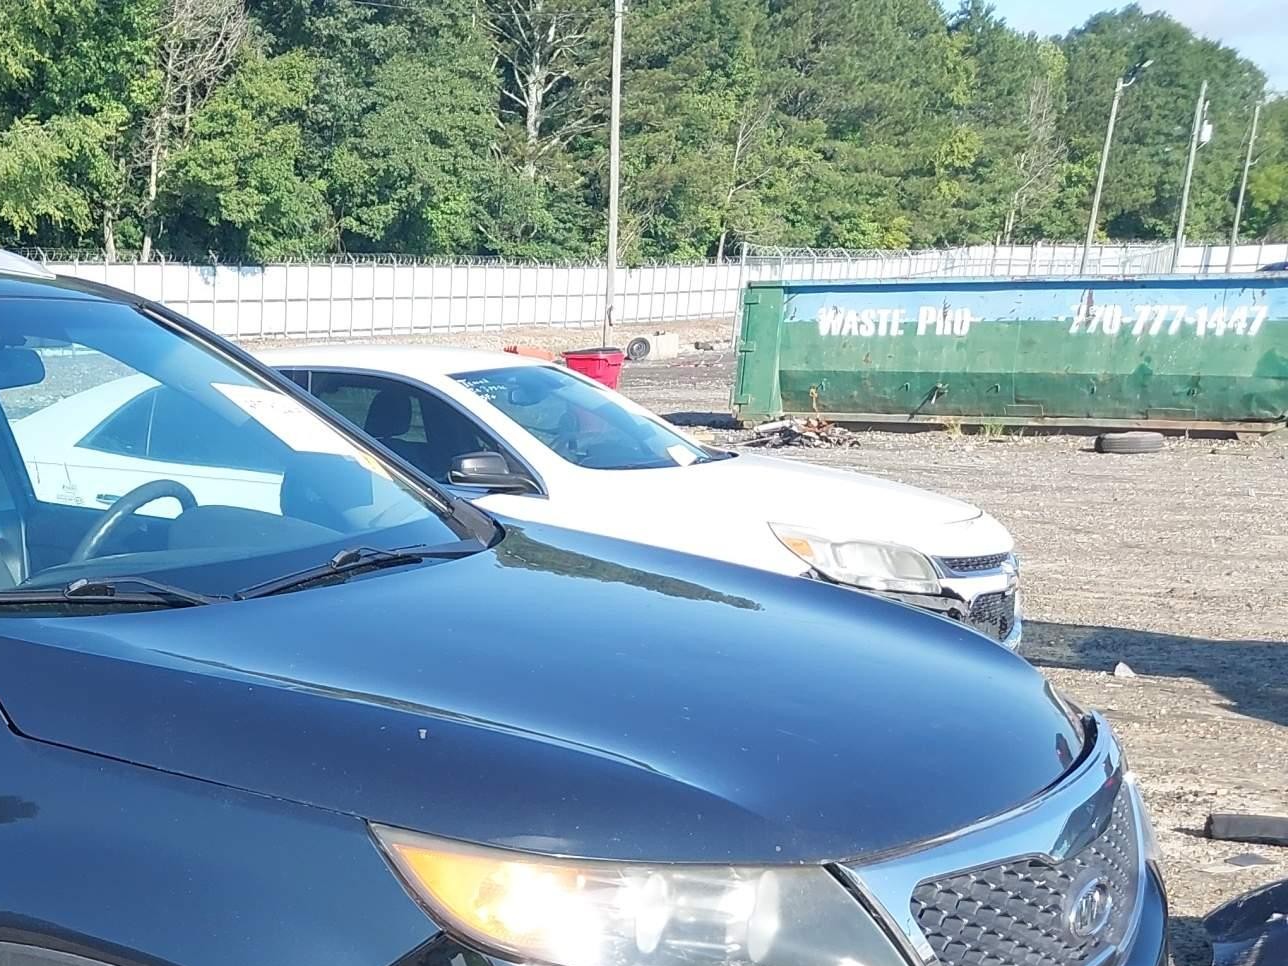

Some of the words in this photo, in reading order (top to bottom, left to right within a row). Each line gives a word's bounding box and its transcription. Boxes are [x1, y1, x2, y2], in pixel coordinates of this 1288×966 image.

[817, 306, 906, 337] WASTE
[916, 305, 971, 337] PRO
[1069, 304, 1269, 337] 770-777-1447
